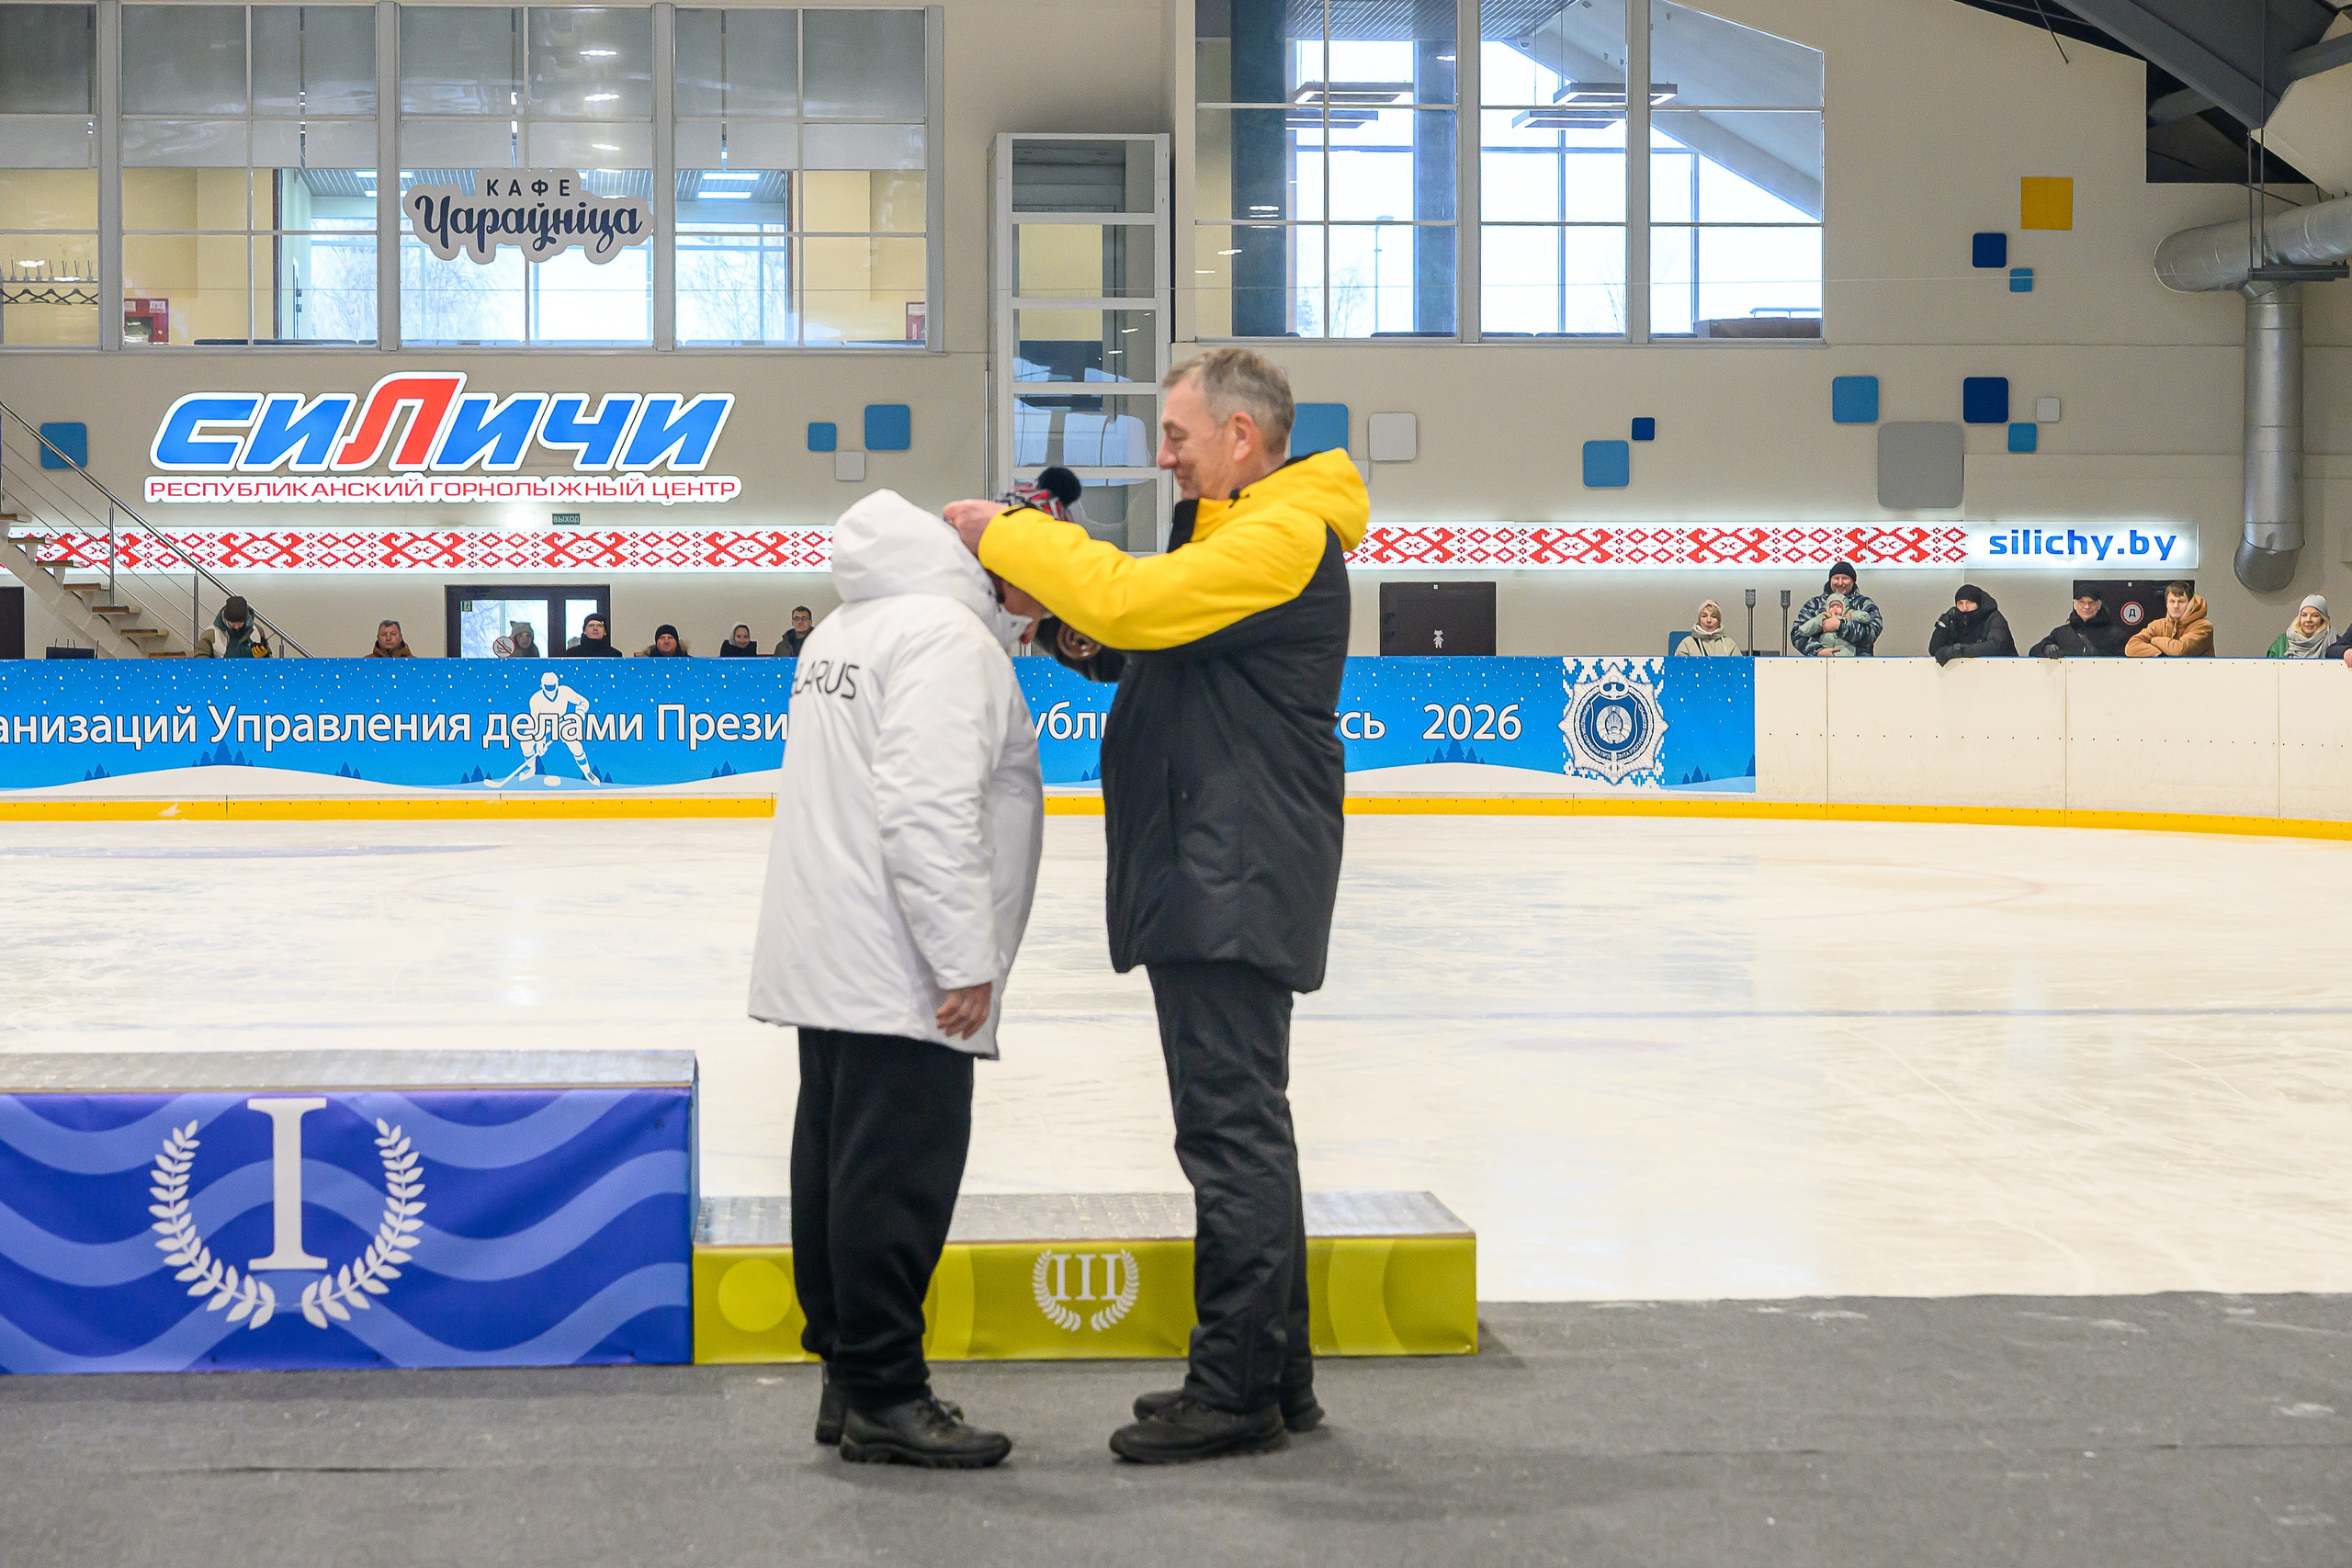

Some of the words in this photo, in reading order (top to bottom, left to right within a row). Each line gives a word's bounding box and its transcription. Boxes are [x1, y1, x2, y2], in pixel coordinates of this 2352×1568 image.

[486, 178, 571, 197] КАФЕ
[414, 195, 643, 254] Чараўніца
[150, 478, 424, 497] РЕСПУБЛИКАНСКИЙ
[430, 478, 645, 497] ГОРНОЛЫЖНЫЙ
[652, 482, 736, 500] ЦЕНТР
[553, 515, 580, 524] ВЫХОД
[1989, 529, 2177, 561] silichy.by
[791, 660, 860, 700] LARUS
[207, 705, 471, 752] Управления
[481, 712, 644, 749] делами
[1333, 710, 1387, 740] сь
[1421, 703, 1523, 740] 2026
[1049, 1253, 1123, 1302] III
